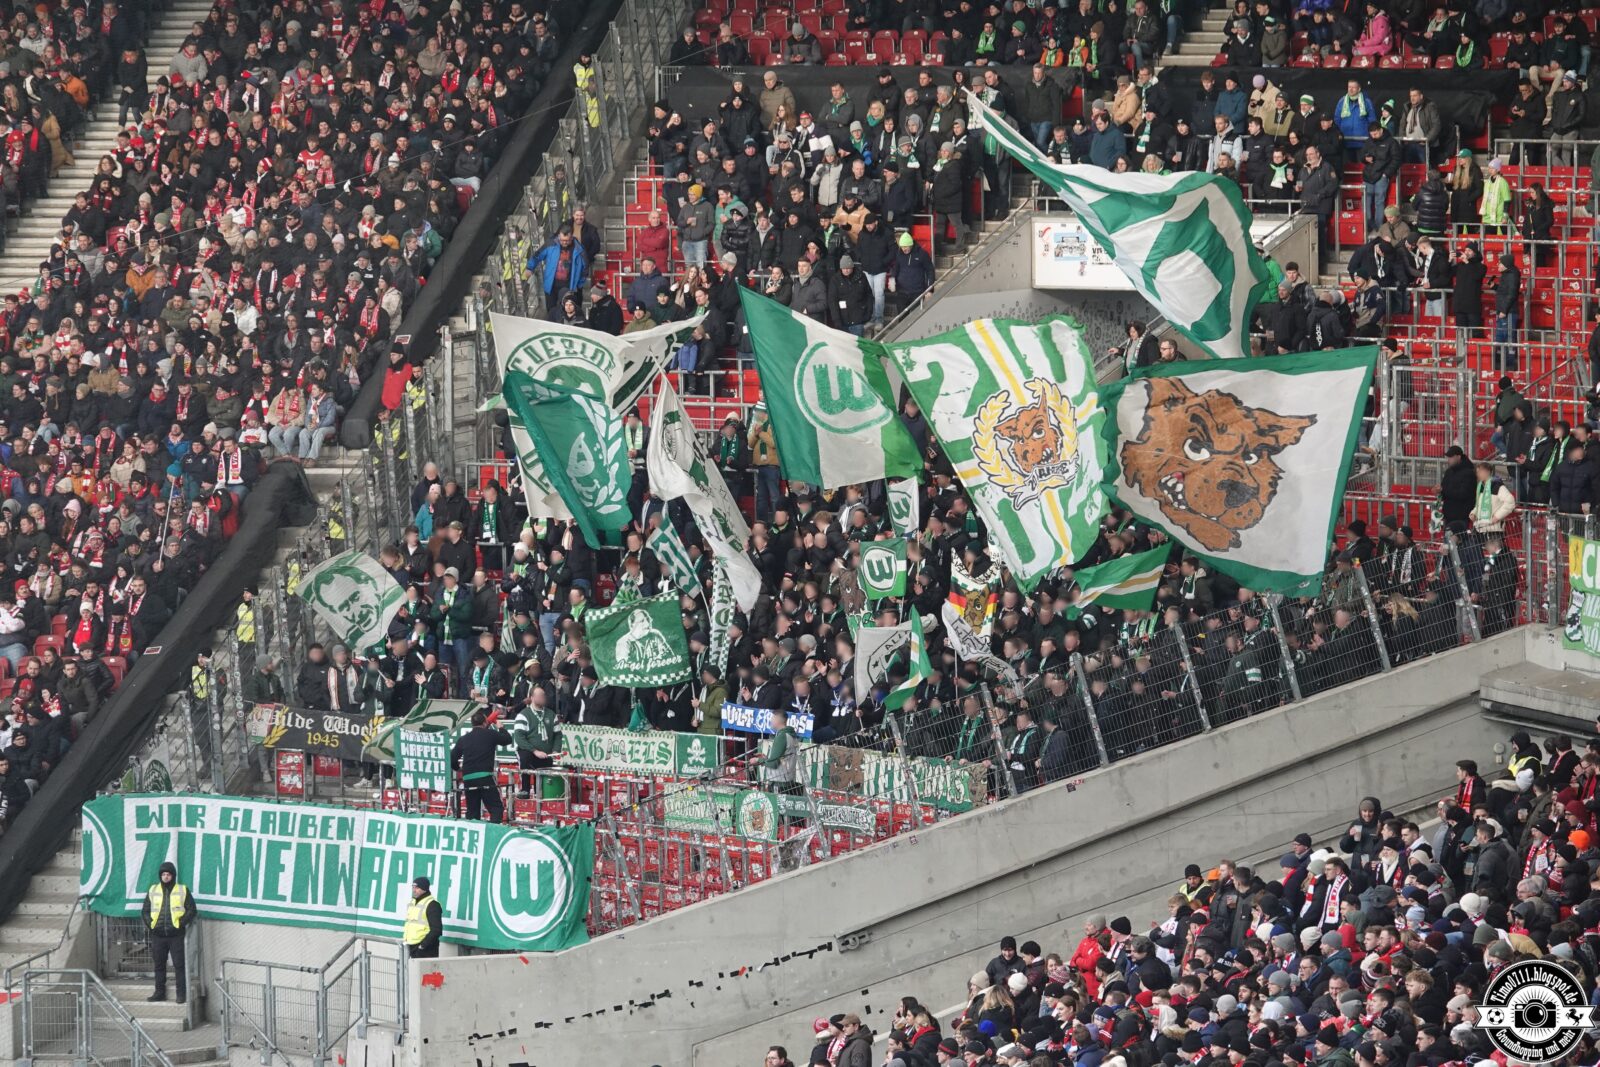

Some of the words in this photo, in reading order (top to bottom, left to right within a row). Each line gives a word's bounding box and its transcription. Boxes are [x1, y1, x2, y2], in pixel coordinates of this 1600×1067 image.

[646, 655, 682, 672] forever
[306, 732, 339, 748] 1945
[400, 742, 445, 759] WAPPEN
[401, 757, 446, 774] JETZT!
[135, 803, 207, 829] WIR
[218, 806, 355, 841] GLAUBEN
[366, 818, 402, 846] AN
[406, 823, 480, 856] UNSER
[134, 830, 479, 921] ZINNENWAPPEN
